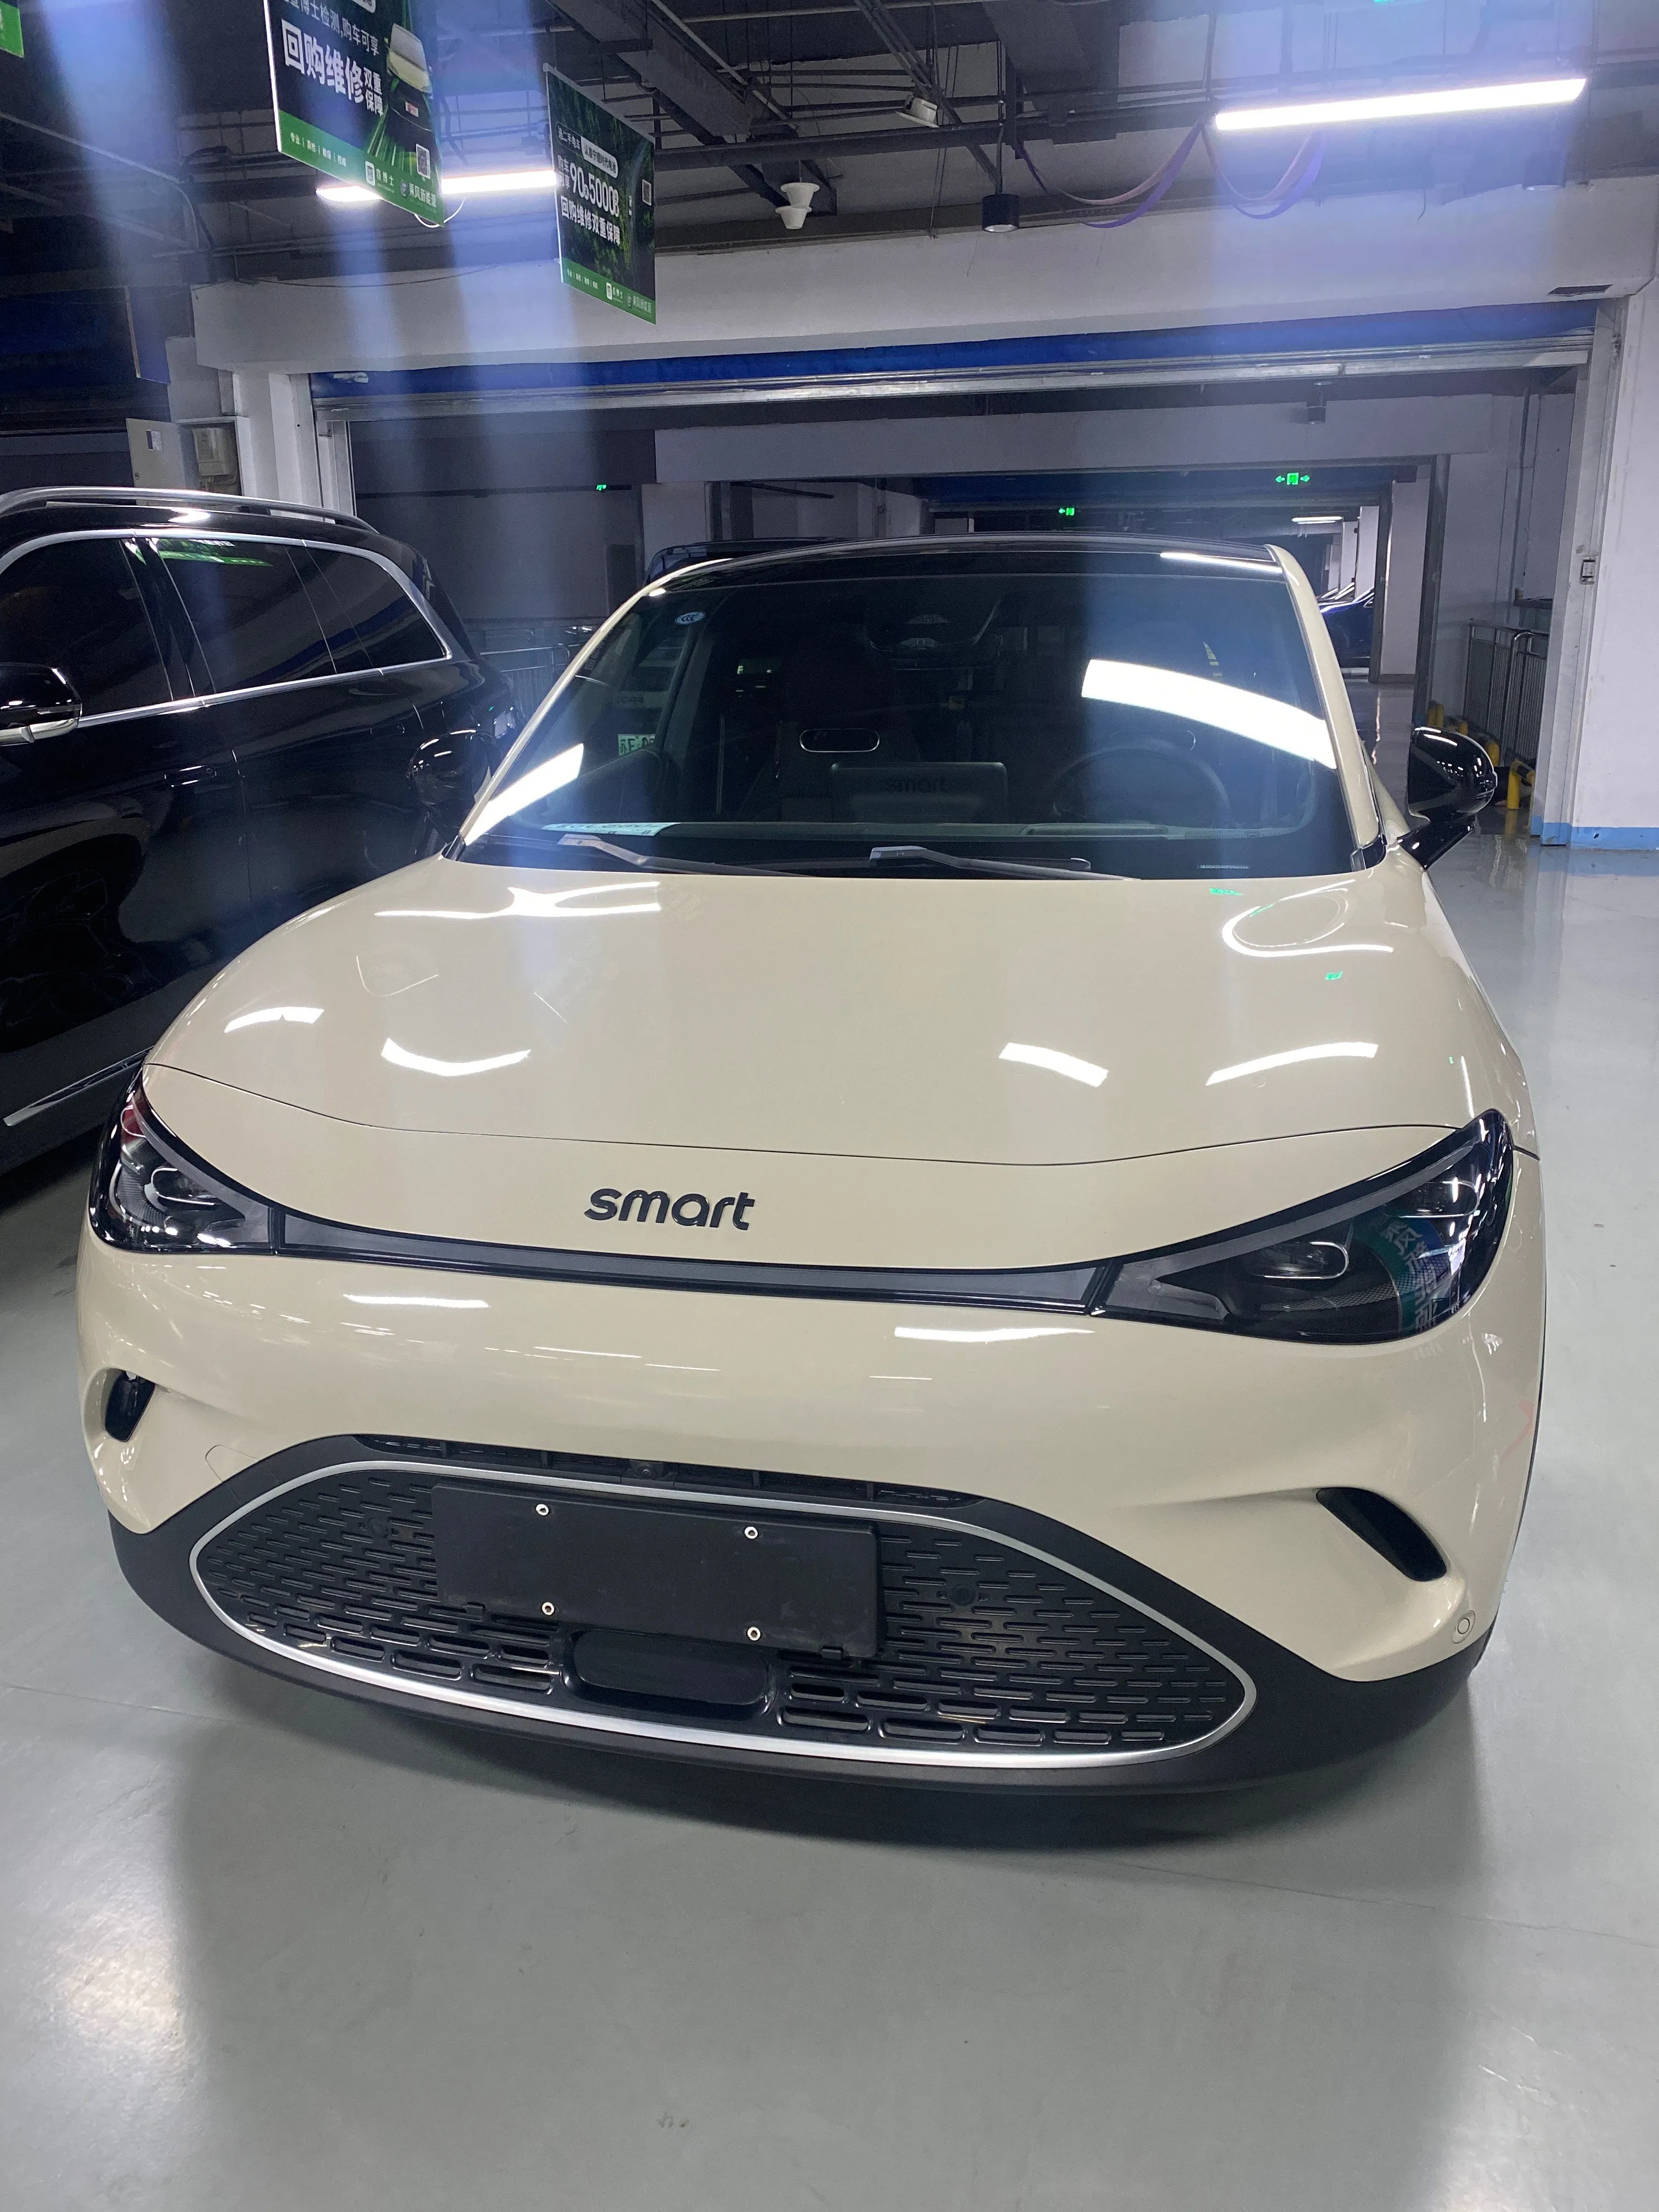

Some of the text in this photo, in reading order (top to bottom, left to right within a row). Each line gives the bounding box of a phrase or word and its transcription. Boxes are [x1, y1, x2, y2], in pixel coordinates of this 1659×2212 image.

[281, 19, 364, 104] 回购维修
[364, 66, 382, 95] 双重
[365, 90, 383, 116] 保障
[560, 195, 621, 247] 回购维修双重保障
[584, 1188, 755, 1231] smart
